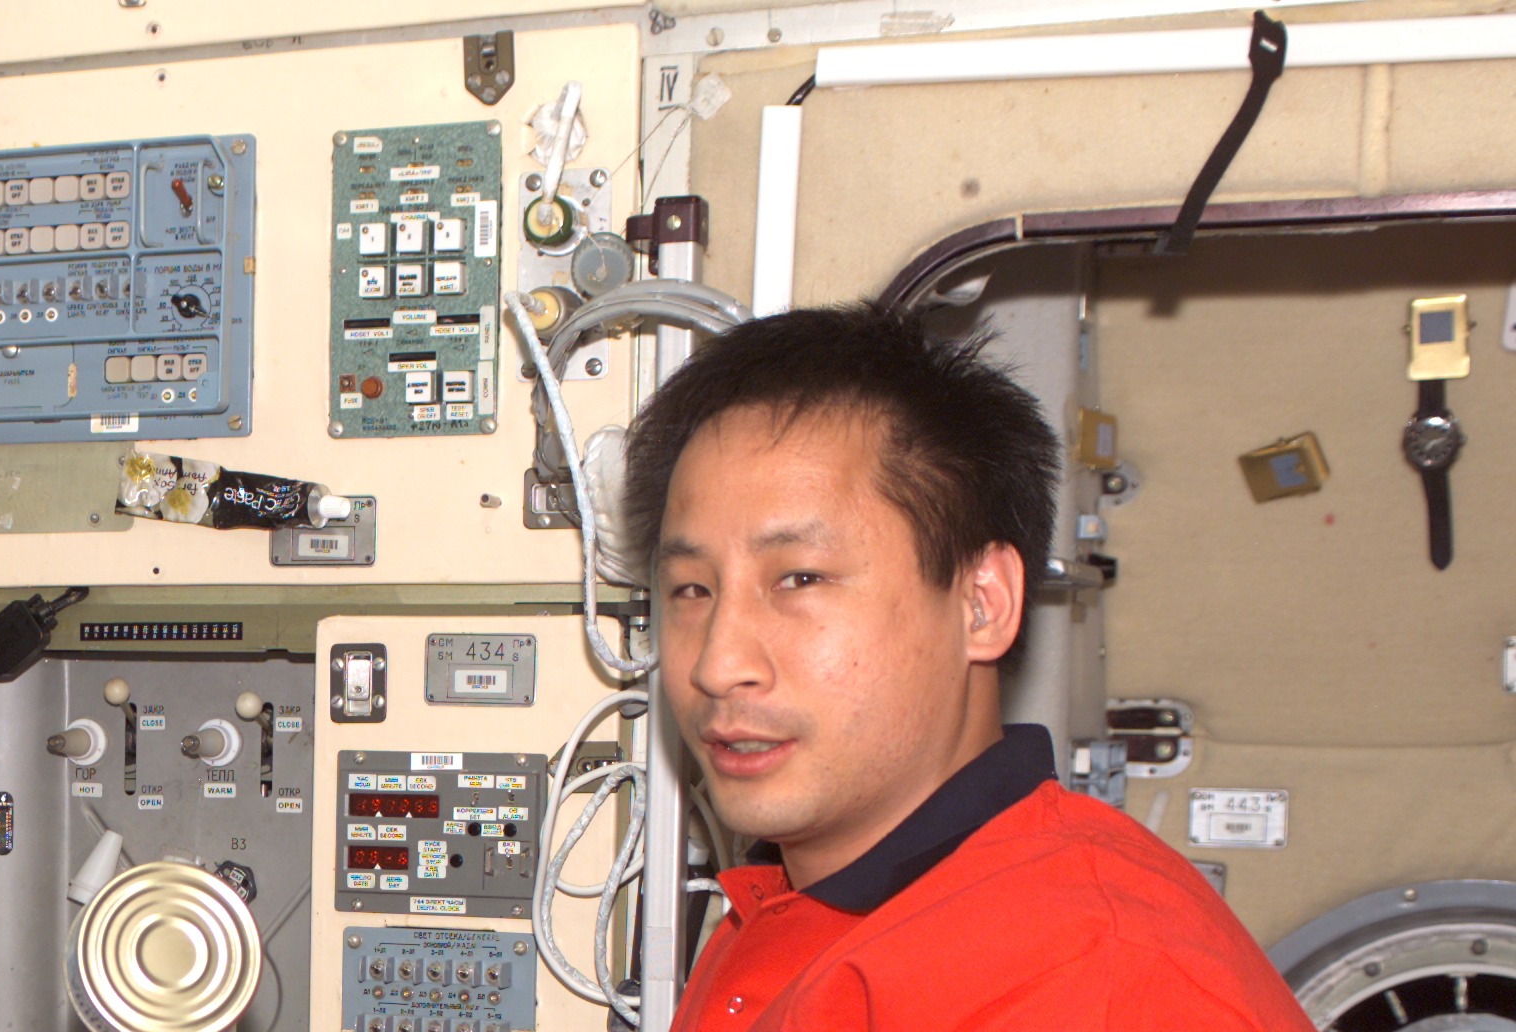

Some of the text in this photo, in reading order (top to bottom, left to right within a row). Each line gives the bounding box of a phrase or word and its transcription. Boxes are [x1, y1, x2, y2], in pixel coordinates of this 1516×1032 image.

[659, 66, 679, 110] IV
[466, 642, 504, 660] 434
[142, 718, 163, 727] CLOSE
[278, 720, 300, 729] CLOSE
[278, 801, 300, 809] OPEN
[1227, 797, 1261, 811] 443
